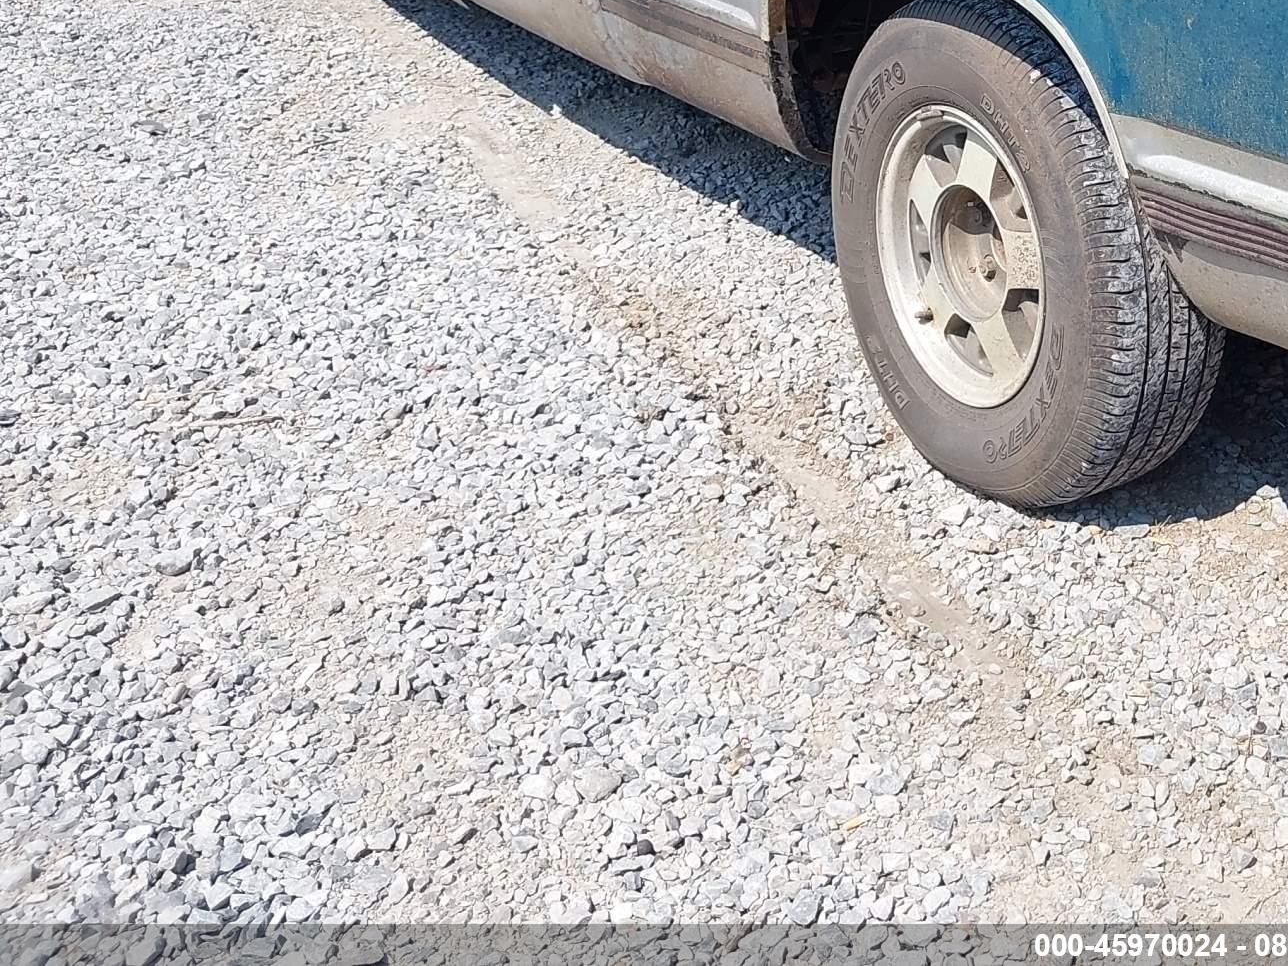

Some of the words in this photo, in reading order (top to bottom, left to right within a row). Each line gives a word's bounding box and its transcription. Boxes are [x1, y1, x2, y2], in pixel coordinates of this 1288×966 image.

[839, 60, 907, 204] DEXTERO
[979, 92, 1031, 174] DHT2
[982, 322, 1065, 464] DEXTERO
